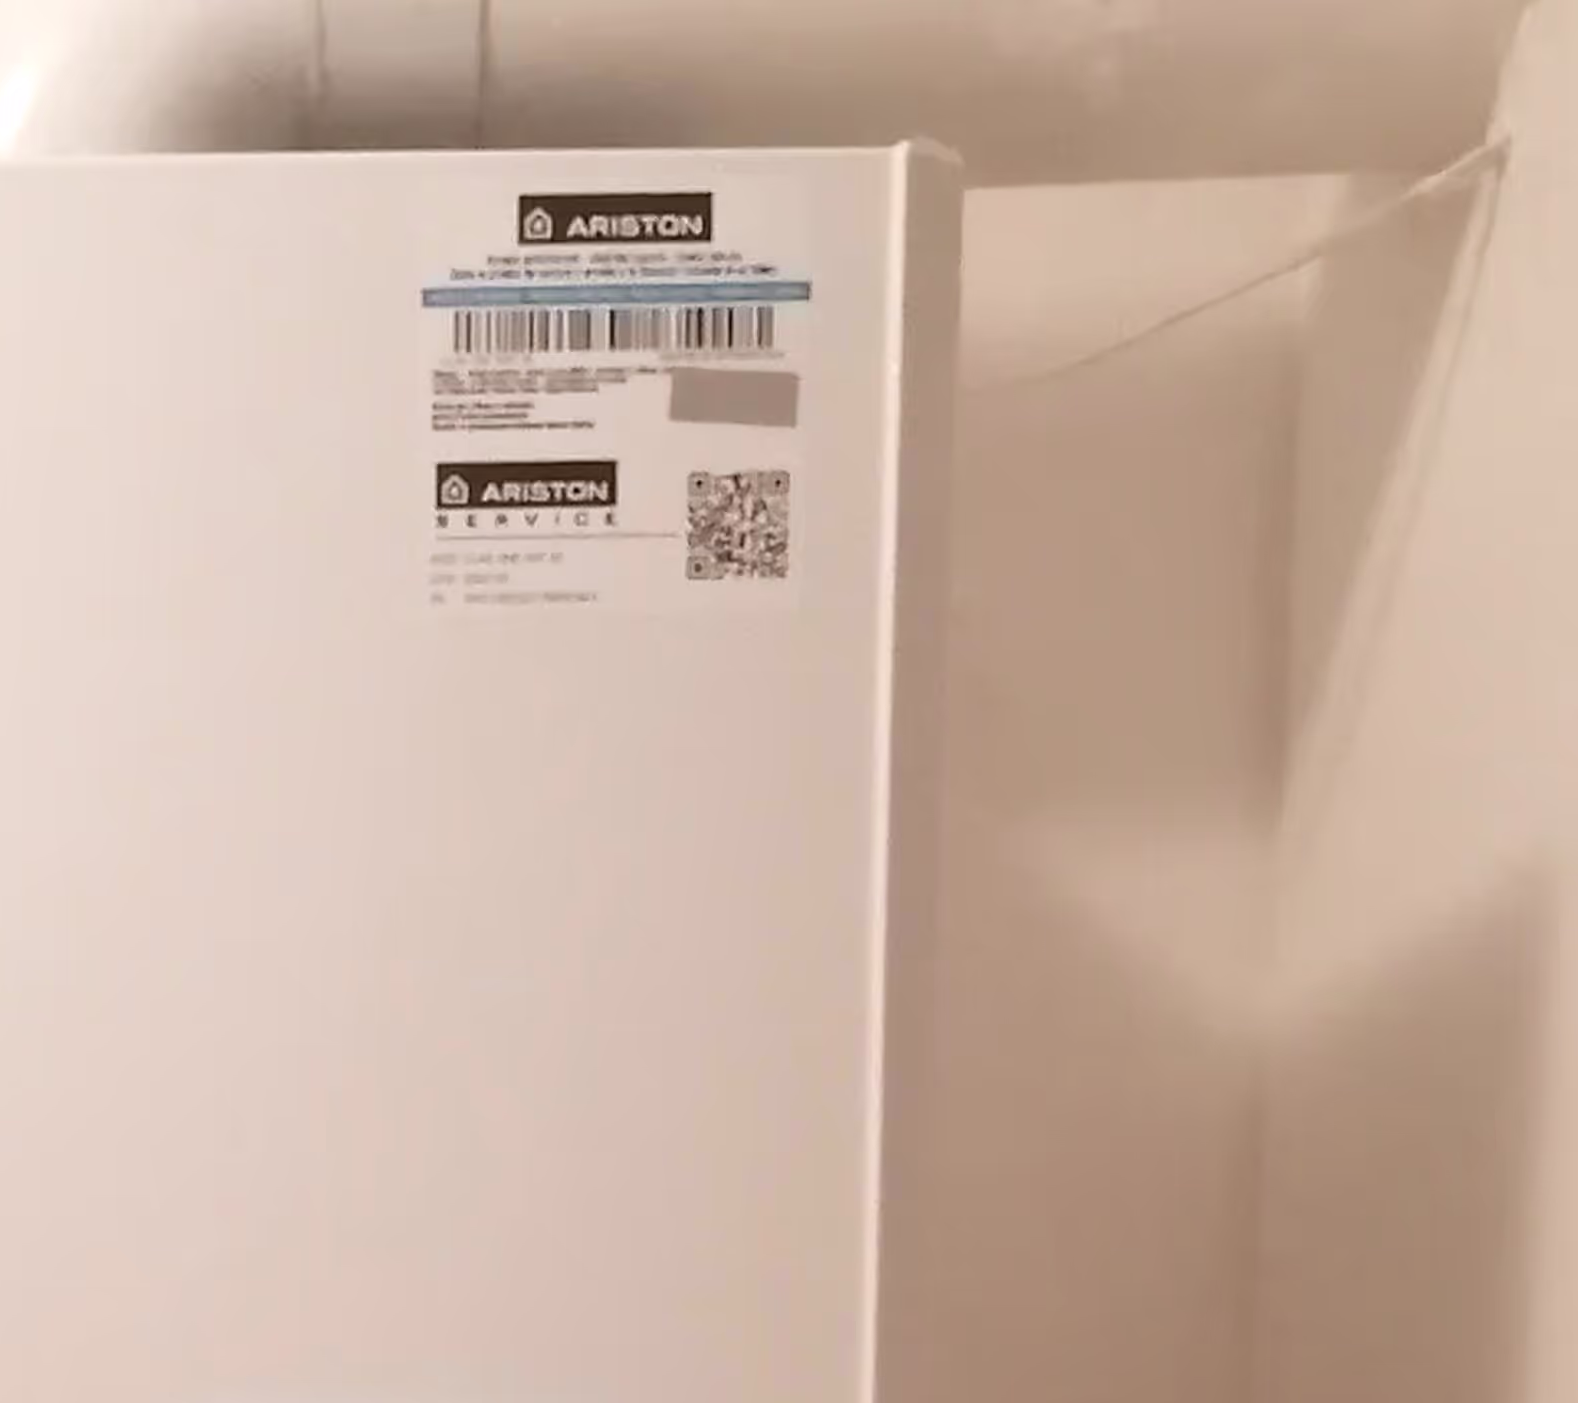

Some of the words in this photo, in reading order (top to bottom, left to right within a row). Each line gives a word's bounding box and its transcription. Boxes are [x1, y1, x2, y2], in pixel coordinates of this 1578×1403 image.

[566, 213, 705, 238] ARISTON
[481, 480, 610, 503] ARISTON
[435, 512, 617, 529] SERVICE
